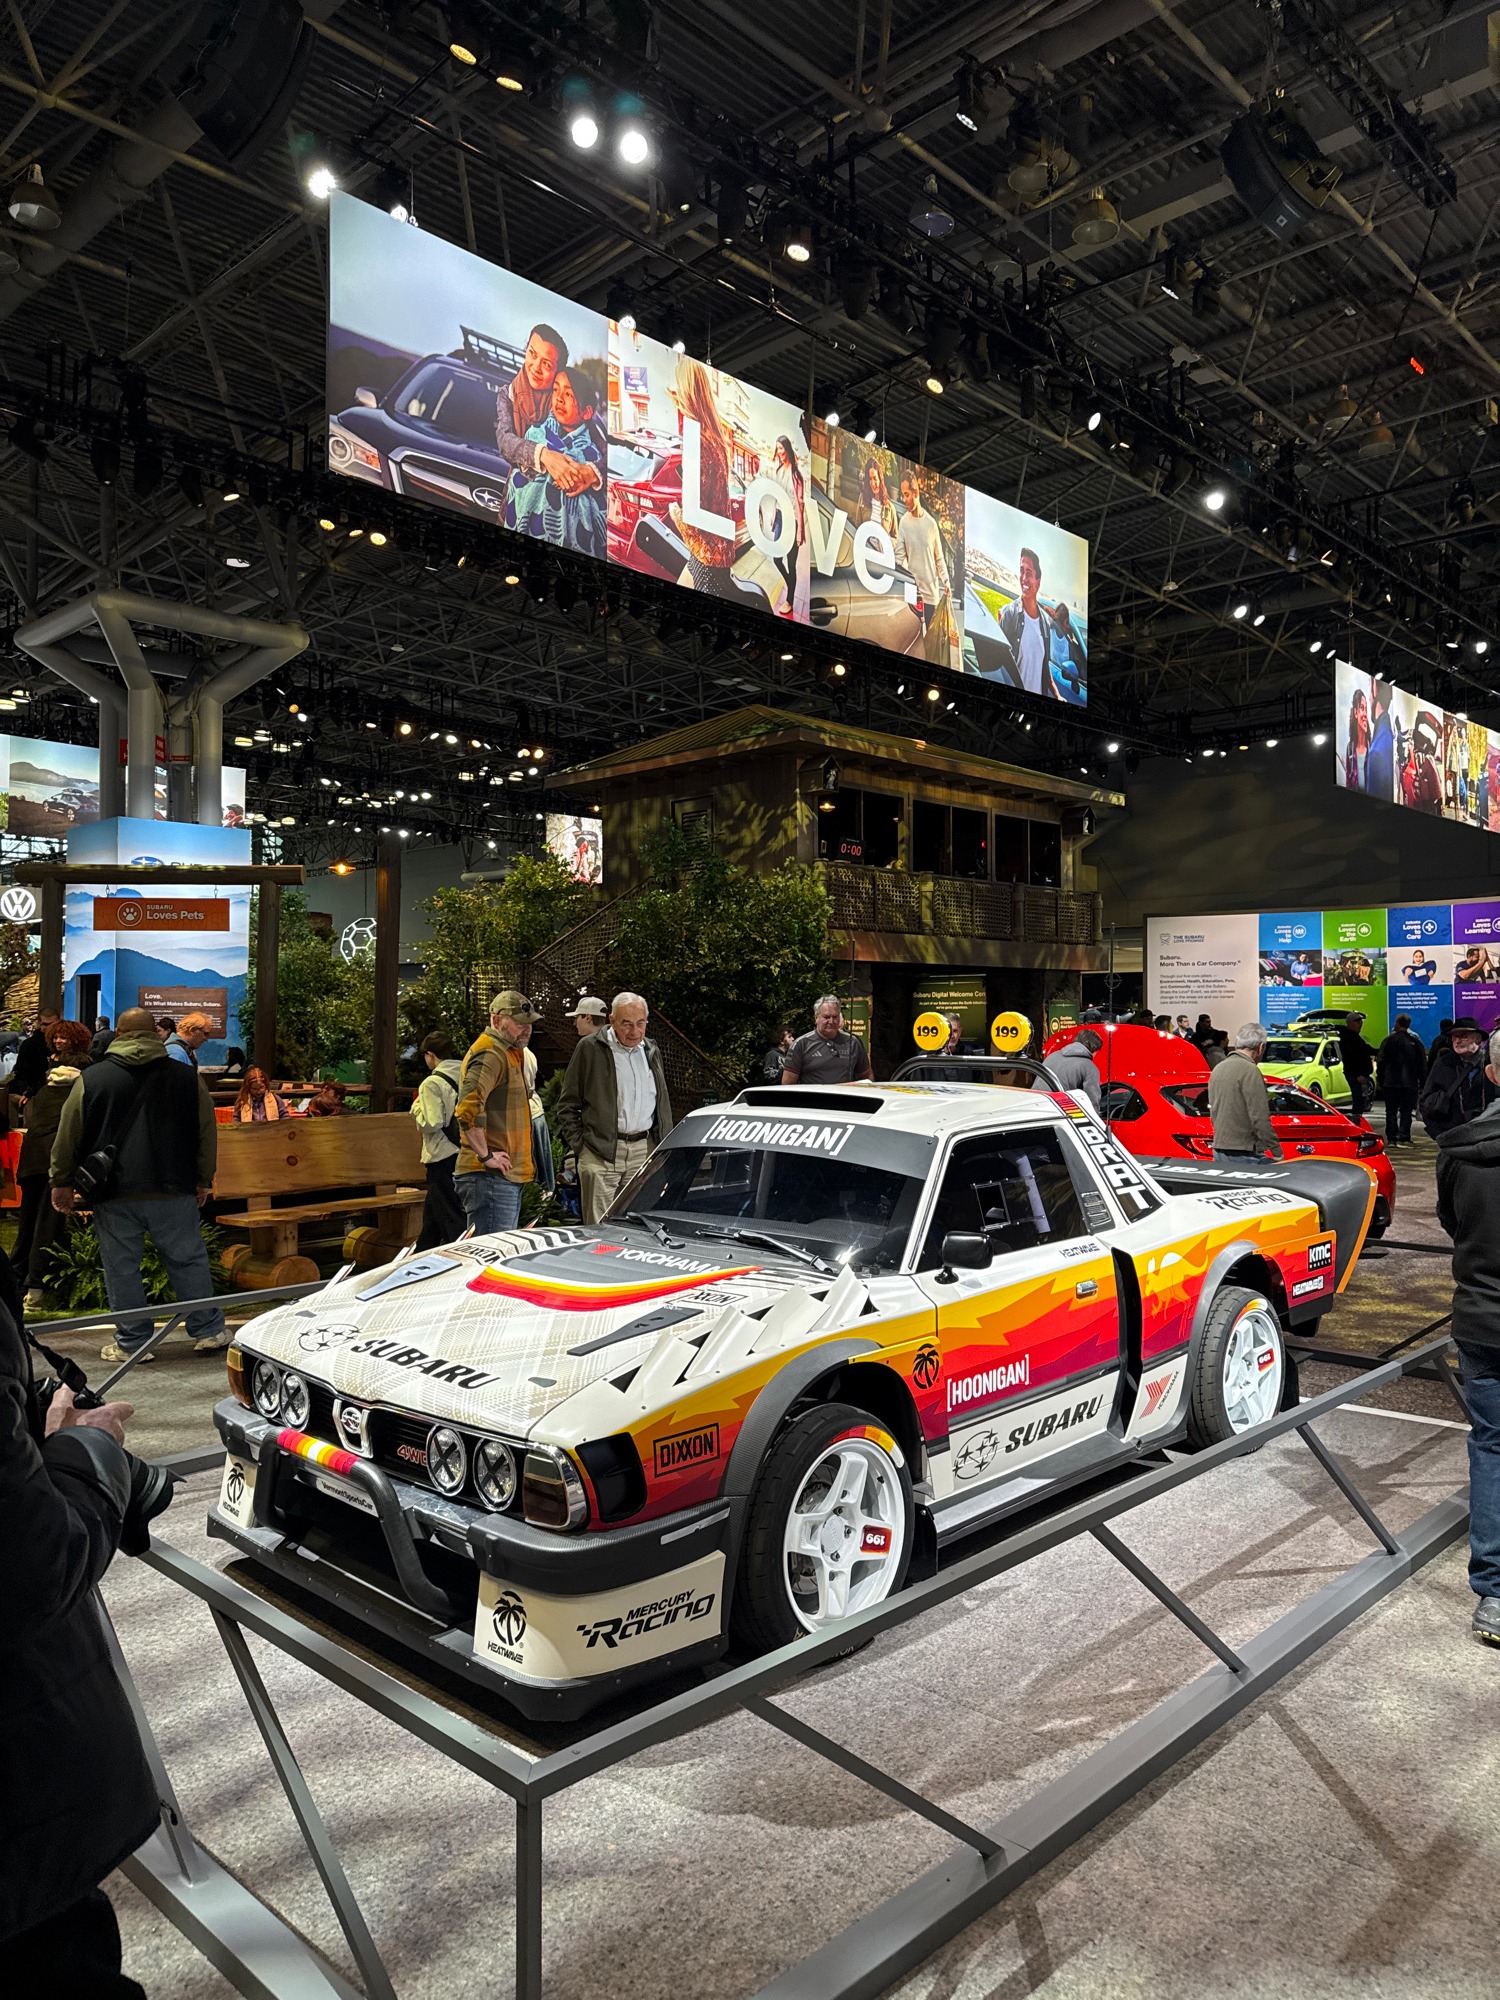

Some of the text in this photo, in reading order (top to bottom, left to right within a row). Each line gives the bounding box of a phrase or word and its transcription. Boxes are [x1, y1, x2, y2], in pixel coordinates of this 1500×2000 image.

[682, 416, 917, 602] Love.
[840, 842, 862, 857] 0:00
[146, 910, 205, 921] Loves Pets
[144, 992, 163, 1000] Love.
[912, 991, 931, 999] Subaru
[931, 991, 949, 999] Digital
[916, 1025, 939, 1038] 199
[995, 1025, 1019, 1038] 199
[700, 1117, 855, 1157] [HOONIGAN]
[1078, 1124, 1152, 1210] BRAT
[1207, 1193, 1292, 1210] Racing
[615, 1247, 722, 1273] YOKOHAMA
[350, 1339, 502, 1390] SUBARU
[946, 1353, 1030, 1412] [HOONIGAN]
[1005, 1394, 1104, 1453] SUBARU
[659, 1430, 715, 1469] DIXXON
[321, 1480, 373, 1511] VermontSportsCar
[865, 1532, 886, 1546] 199
[626, 1588, 696, 1621] MERCURY
[585, 1593, 716, 1649] Racing
[487, 1640, 524, 1665] HEATWAVE
